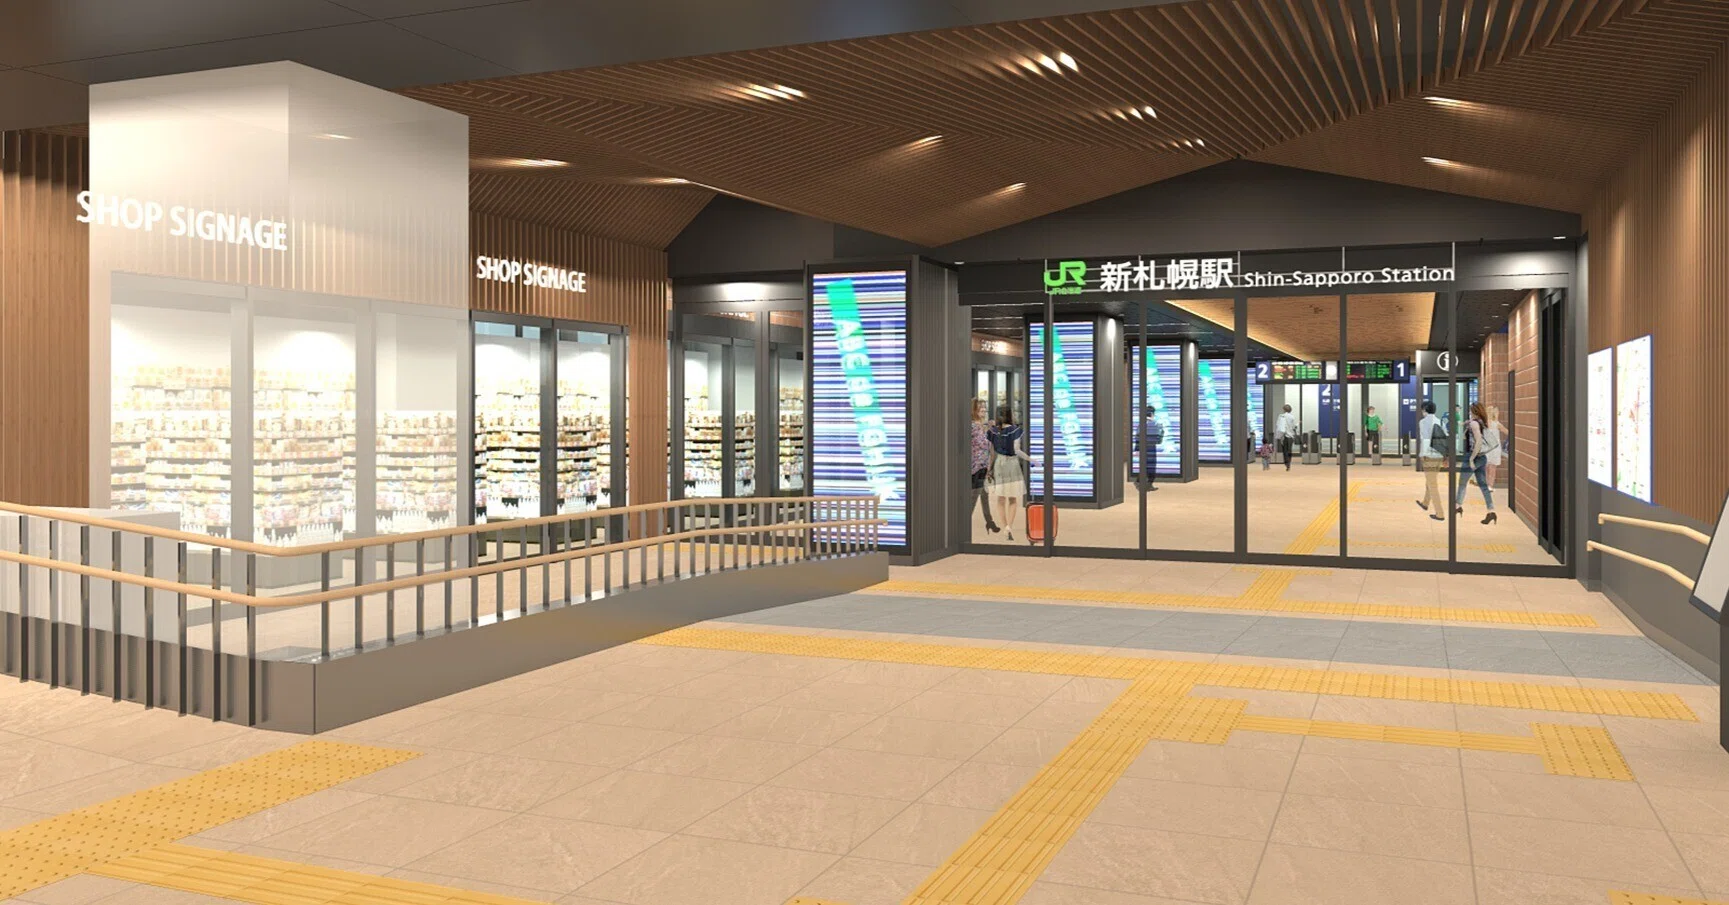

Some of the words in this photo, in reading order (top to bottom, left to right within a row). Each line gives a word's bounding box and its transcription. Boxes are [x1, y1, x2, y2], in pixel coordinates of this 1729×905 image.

[76, 190, 163, 232] SHOP
[170, 206, 288, 251] SIGNAGE
[476, 255, 521, 283] SHOP
[523, 263, 587, 293] SIGNAGE
[1044, 261, 1087, 286] JR
[1100, 258, 1233, 292] 新札幌駅
[1244, 270, 1374, 288] Shin-Sapporo
[1382, 265, 1455, 282] Station
[1257, 363, 1269, 379] 2
[1397, 362, 1405, 377] 1
